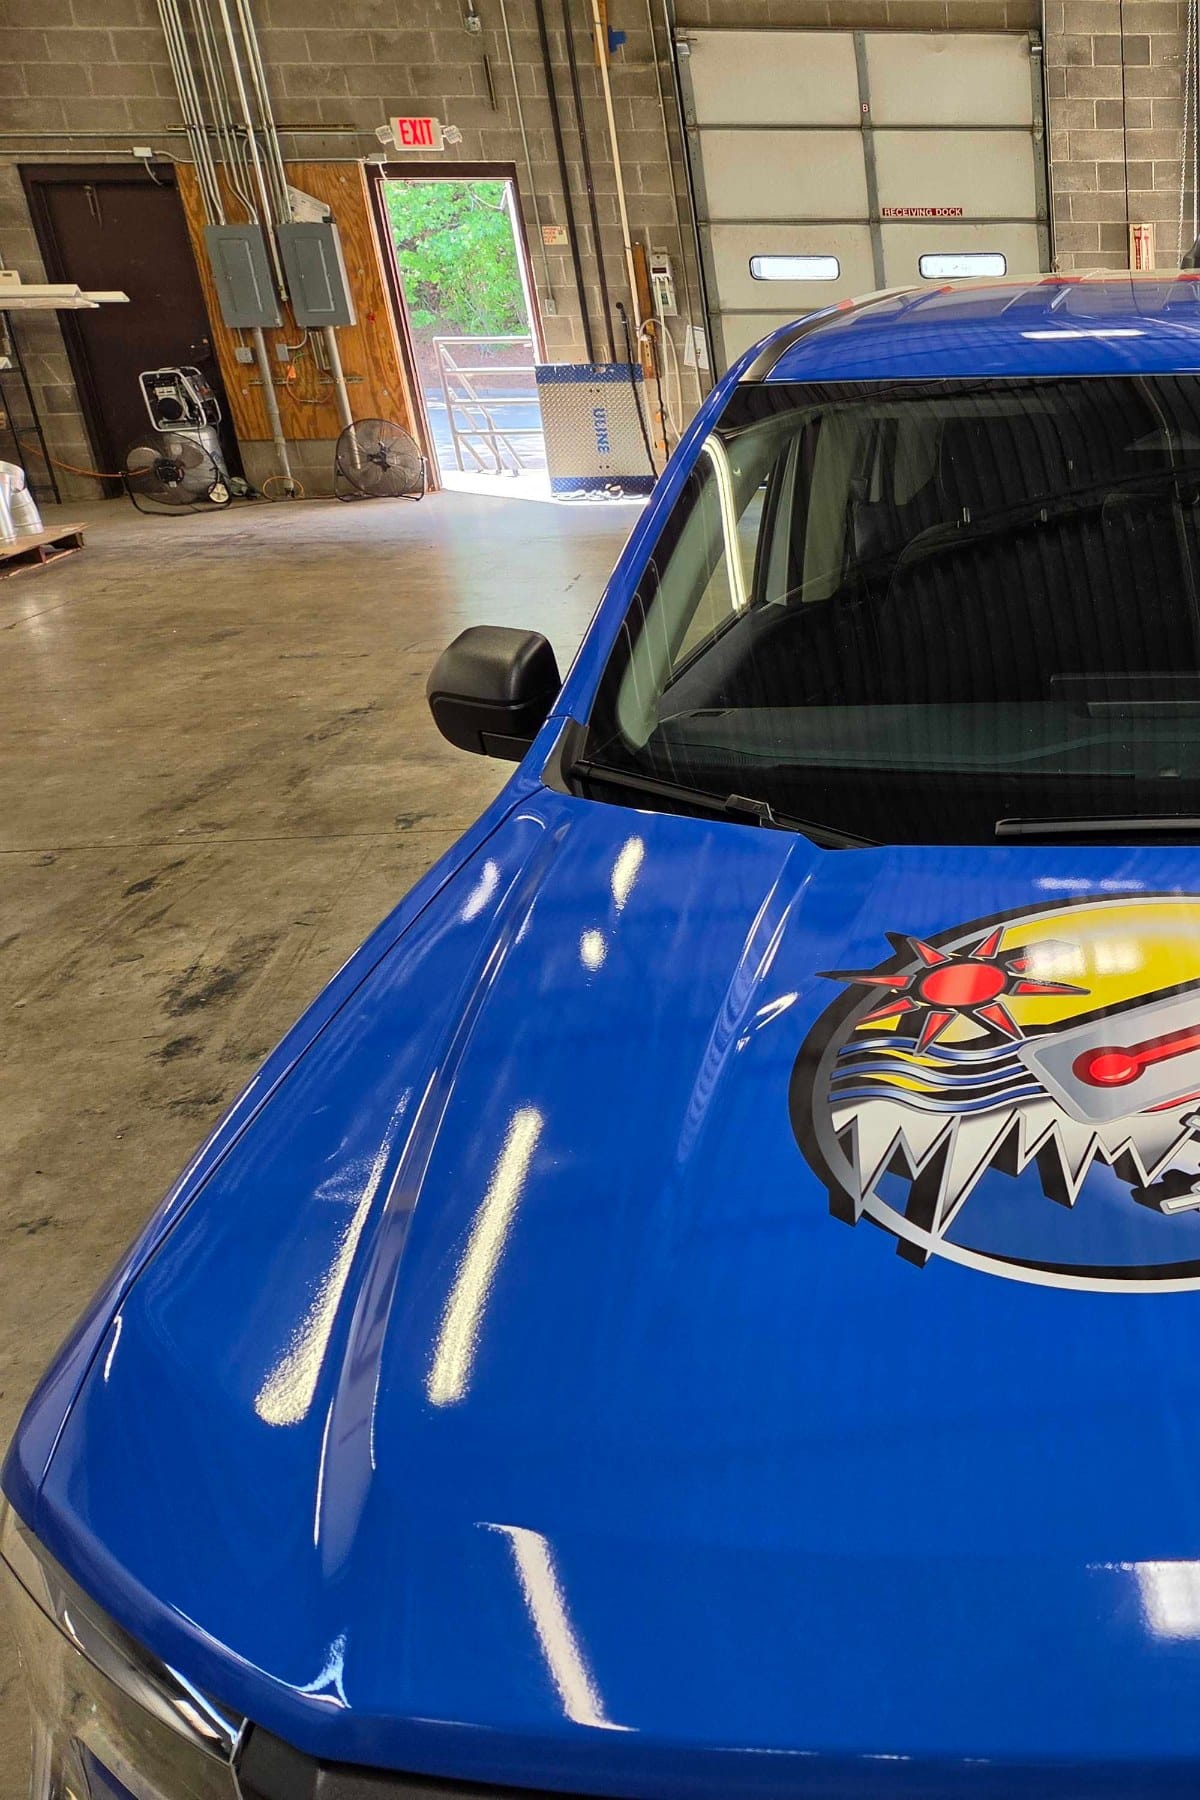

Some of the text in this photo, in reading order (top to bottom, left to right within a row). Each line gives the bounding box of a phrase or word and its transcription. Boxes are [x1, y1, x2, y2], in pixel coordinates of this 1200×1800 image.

[398, 119, 433, 145] EXIT
[884, 207, 962, 217] RECEIVING DOCK
[592, 407, 610, 454] ULINE
